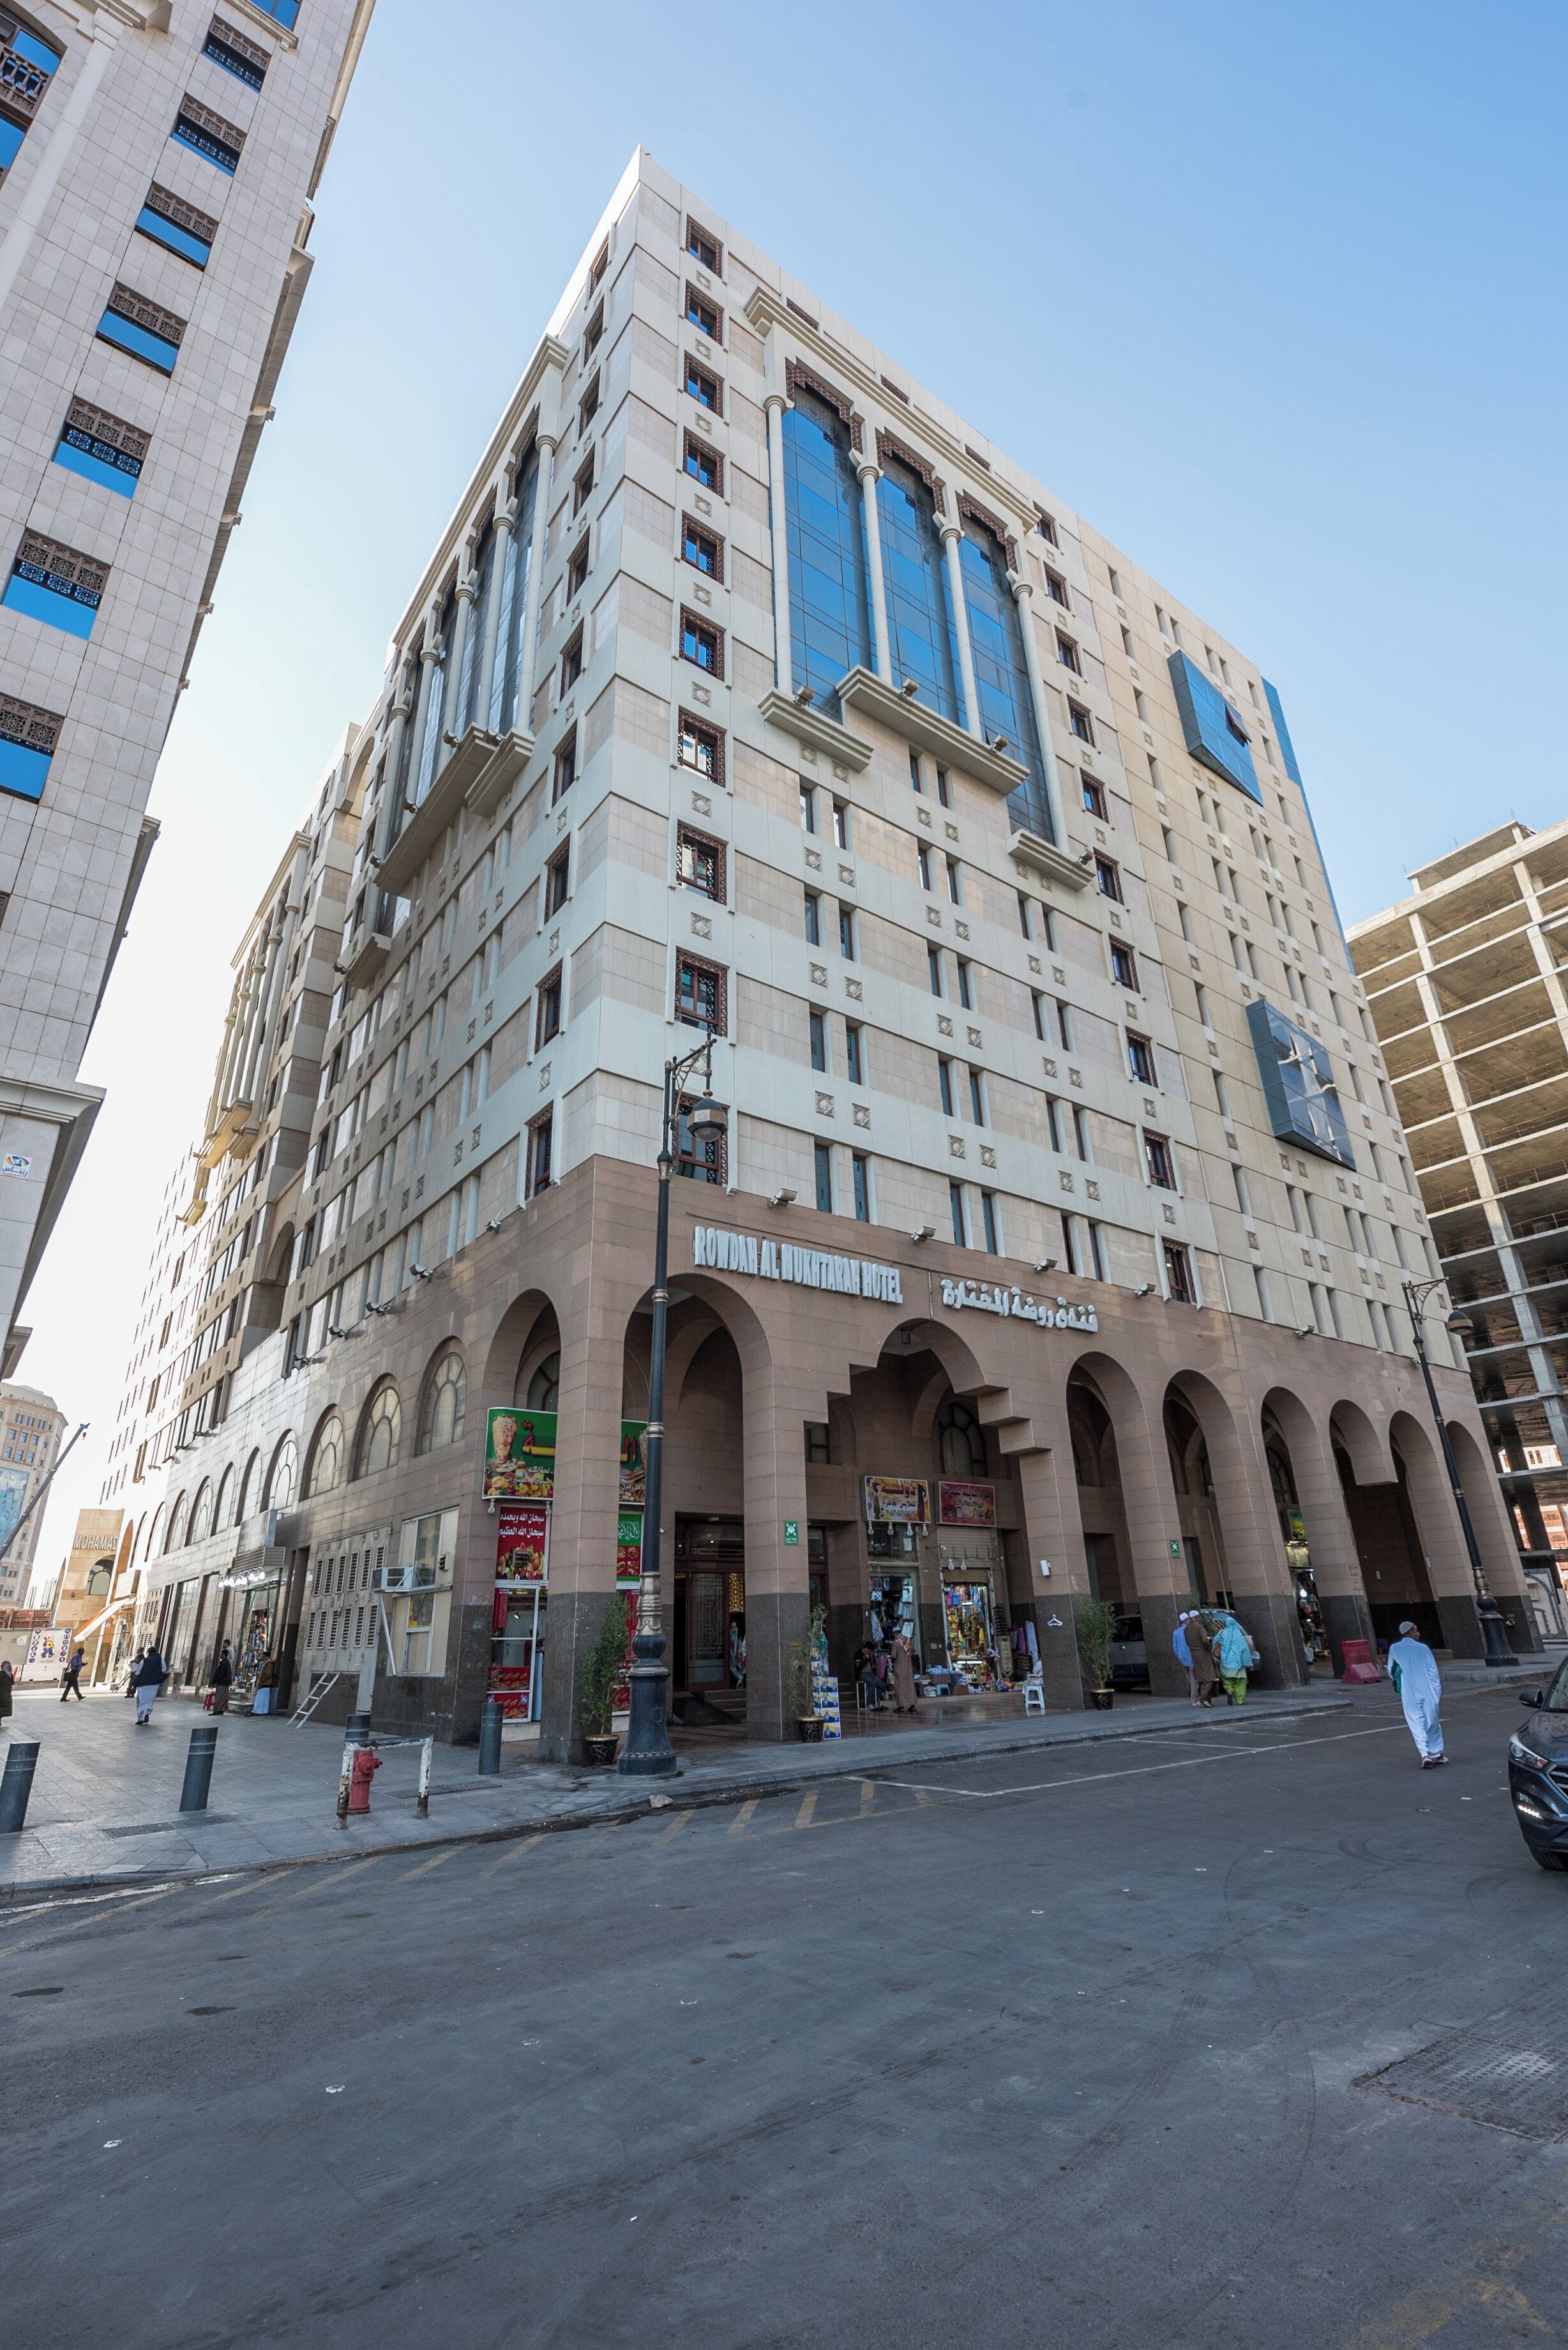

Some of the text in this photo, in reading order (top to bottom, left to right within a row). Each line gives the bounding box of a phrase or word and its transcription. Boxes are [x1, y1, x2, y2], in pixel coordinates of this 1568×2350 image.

[694, 1225, 903, 1304] ROWDAH AL MUKHTARAH HOTEL
[940, 1278, 1098, 1333] فندق روضة المختارة
[500, 1512, 545, 1524] سبحان الله وبحمده
[499, 1526, 544, 1538] سبحان الله العظيم
[73, 1534, 119, 1550] MOHAMAD
